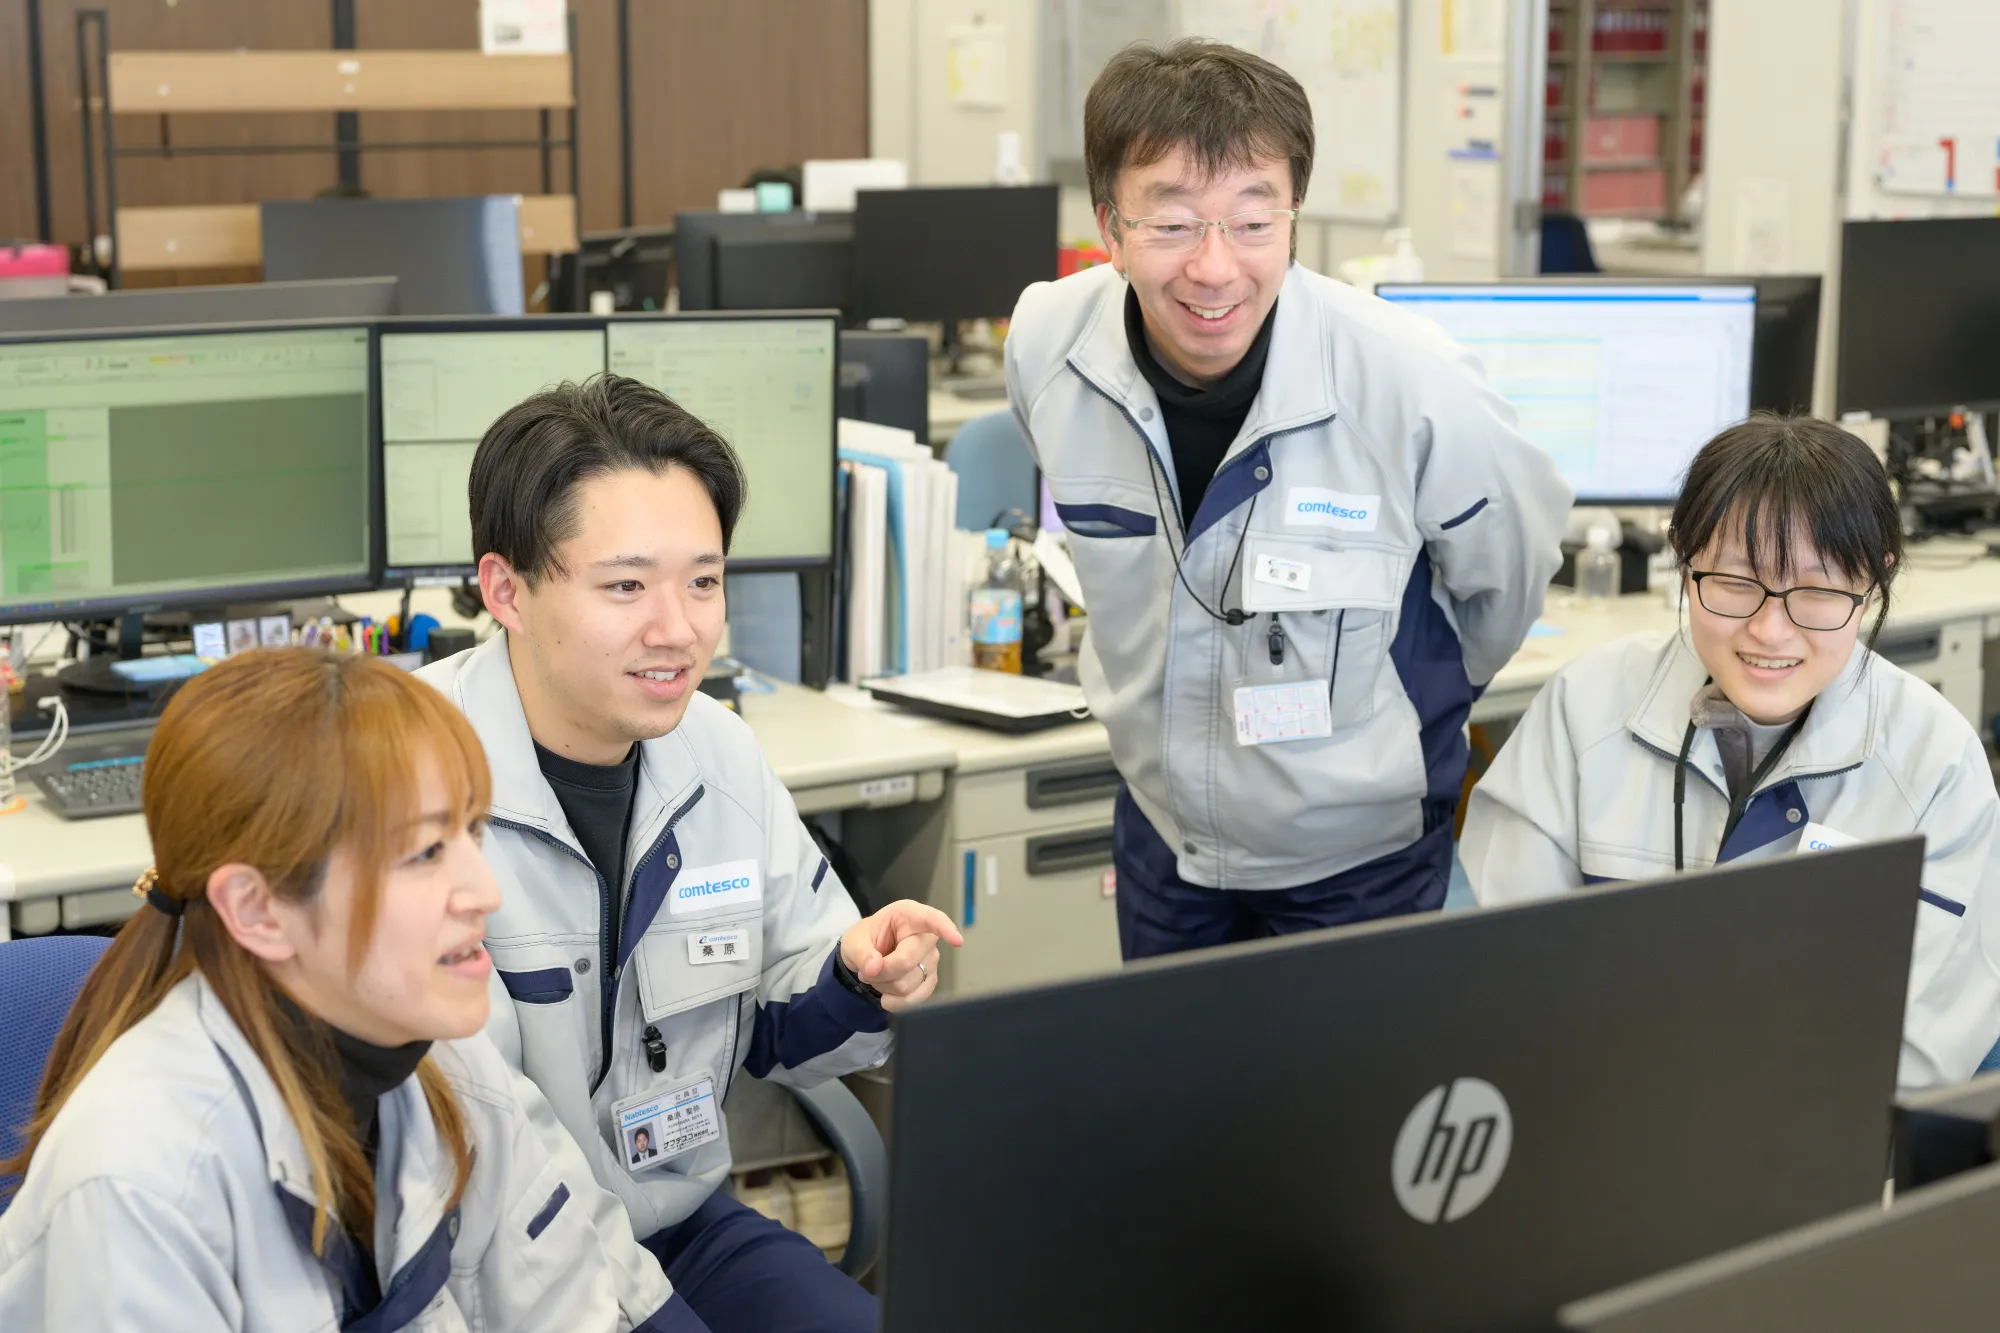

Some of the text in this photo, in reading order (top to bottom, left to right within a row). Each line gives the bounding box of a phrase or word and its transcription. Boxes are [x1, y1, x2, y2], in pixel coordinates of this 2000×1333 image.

[1297, 501, 1368, 520] comtesco
[678, 877, 750, 899] comtesco
[708, 934, 738, 943] comtesco
[624, 1104, 659, 1122] Nabtesco
[1407, 1082, 1499, 1222] hp
